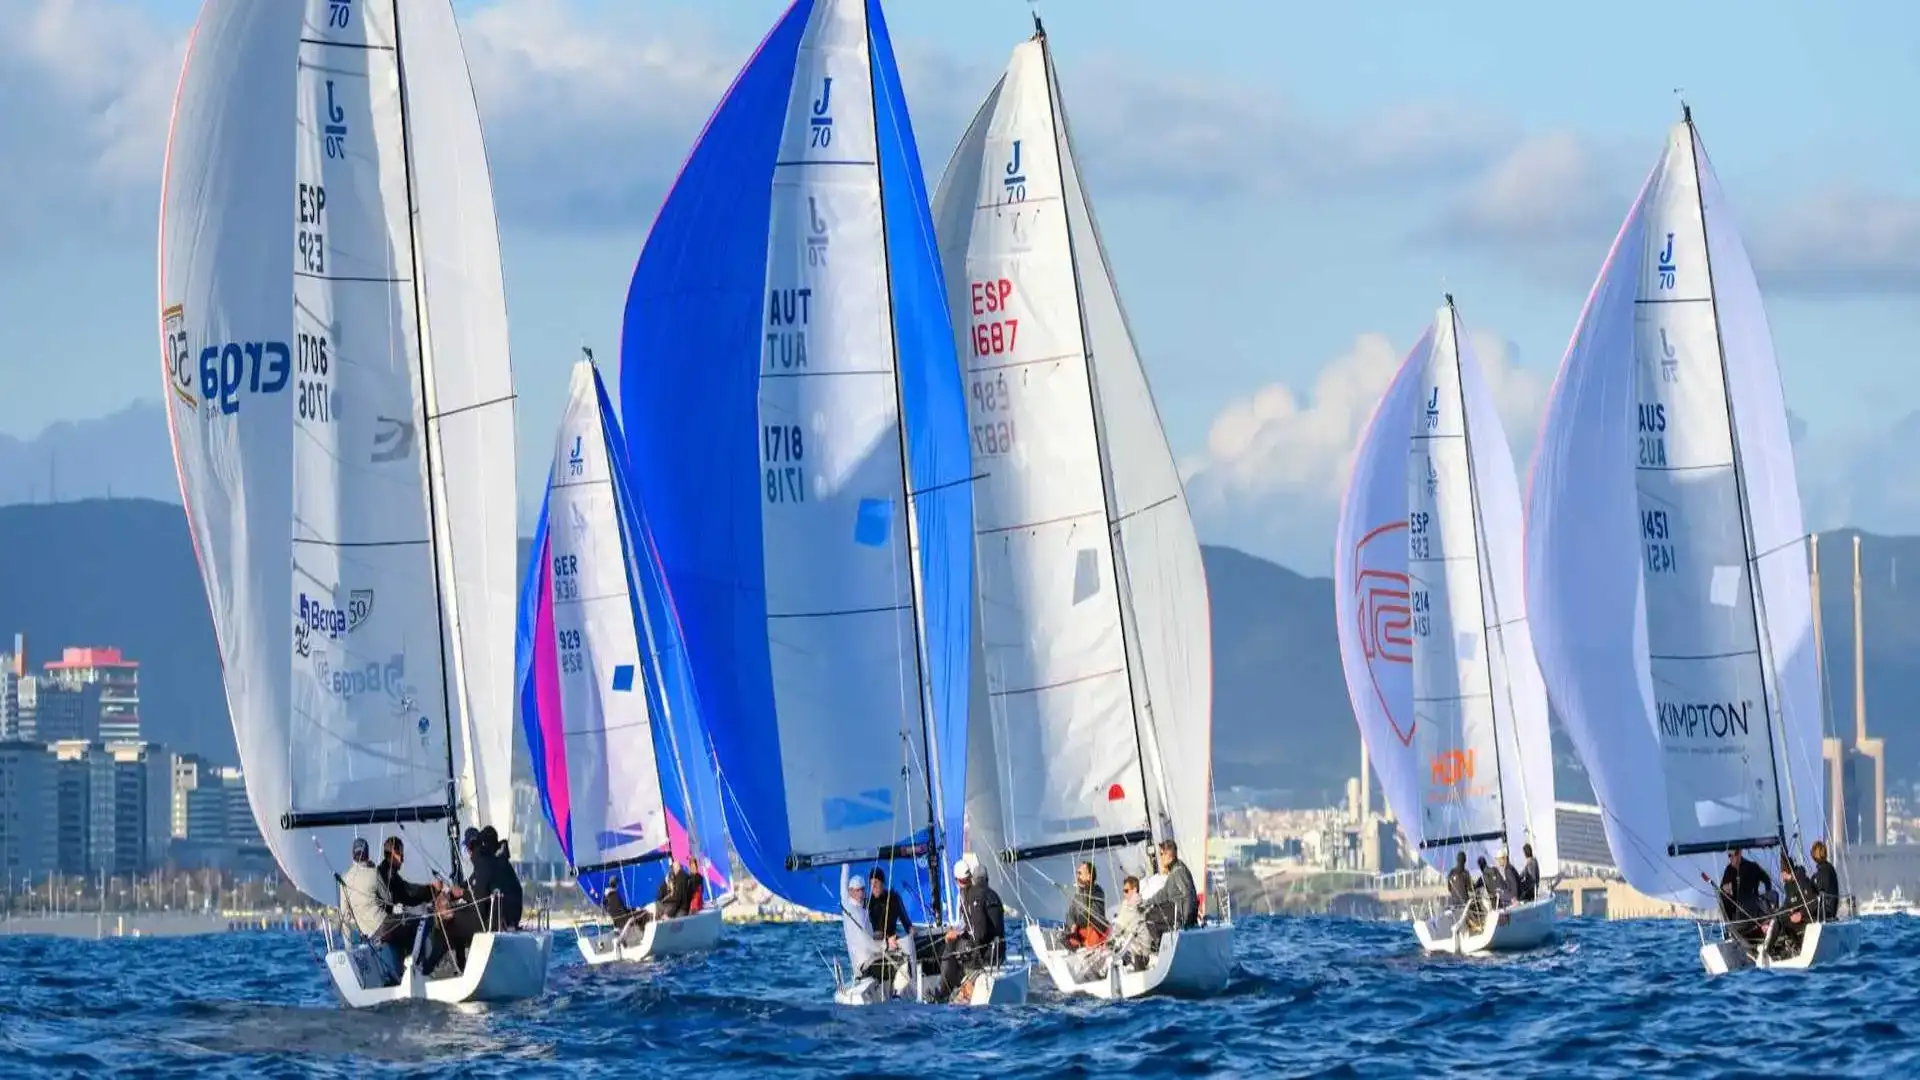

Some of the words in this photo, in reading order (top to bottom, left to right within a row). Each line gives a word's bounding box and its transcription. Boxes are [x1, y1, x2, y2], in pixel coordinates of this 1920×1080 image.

[329, 4, 350, 29] 70
[813, 78, 832, 115] J
[812, 127, 831, 148] 70
[1006, 140, 1021, 175] J
[299, 183, 326, 225] ESP
[1006, 184, 1026, 204] 70
[1660, 233, 1674, 264] J
[1659, 273, 1675, 289] 70
[770, 289, 811, 325] AUT
[972, 278, 1011, 315] ESP
[972, 319, 1018, 357] 1687
[298, 333, 328, 376] 1706
[1428, 386, 1438, 409] J
[1639, 403, 1666, 431] AUS
[571, 436, 582, 458] J
[765, 426, 803, 461] 1718
[571, 464, 583, 476] 70
[1411, 513, 1429, 534] ESP
[1641, 511, 1668, 539] 1451
[554, 555, 577, 577] GER
[311, 601, 345, 638] Berga
[350, 601, 365, 624] 50
[559, 630, 580, 649] 929
[1657, 701, 1748, 738] KIMPTON
